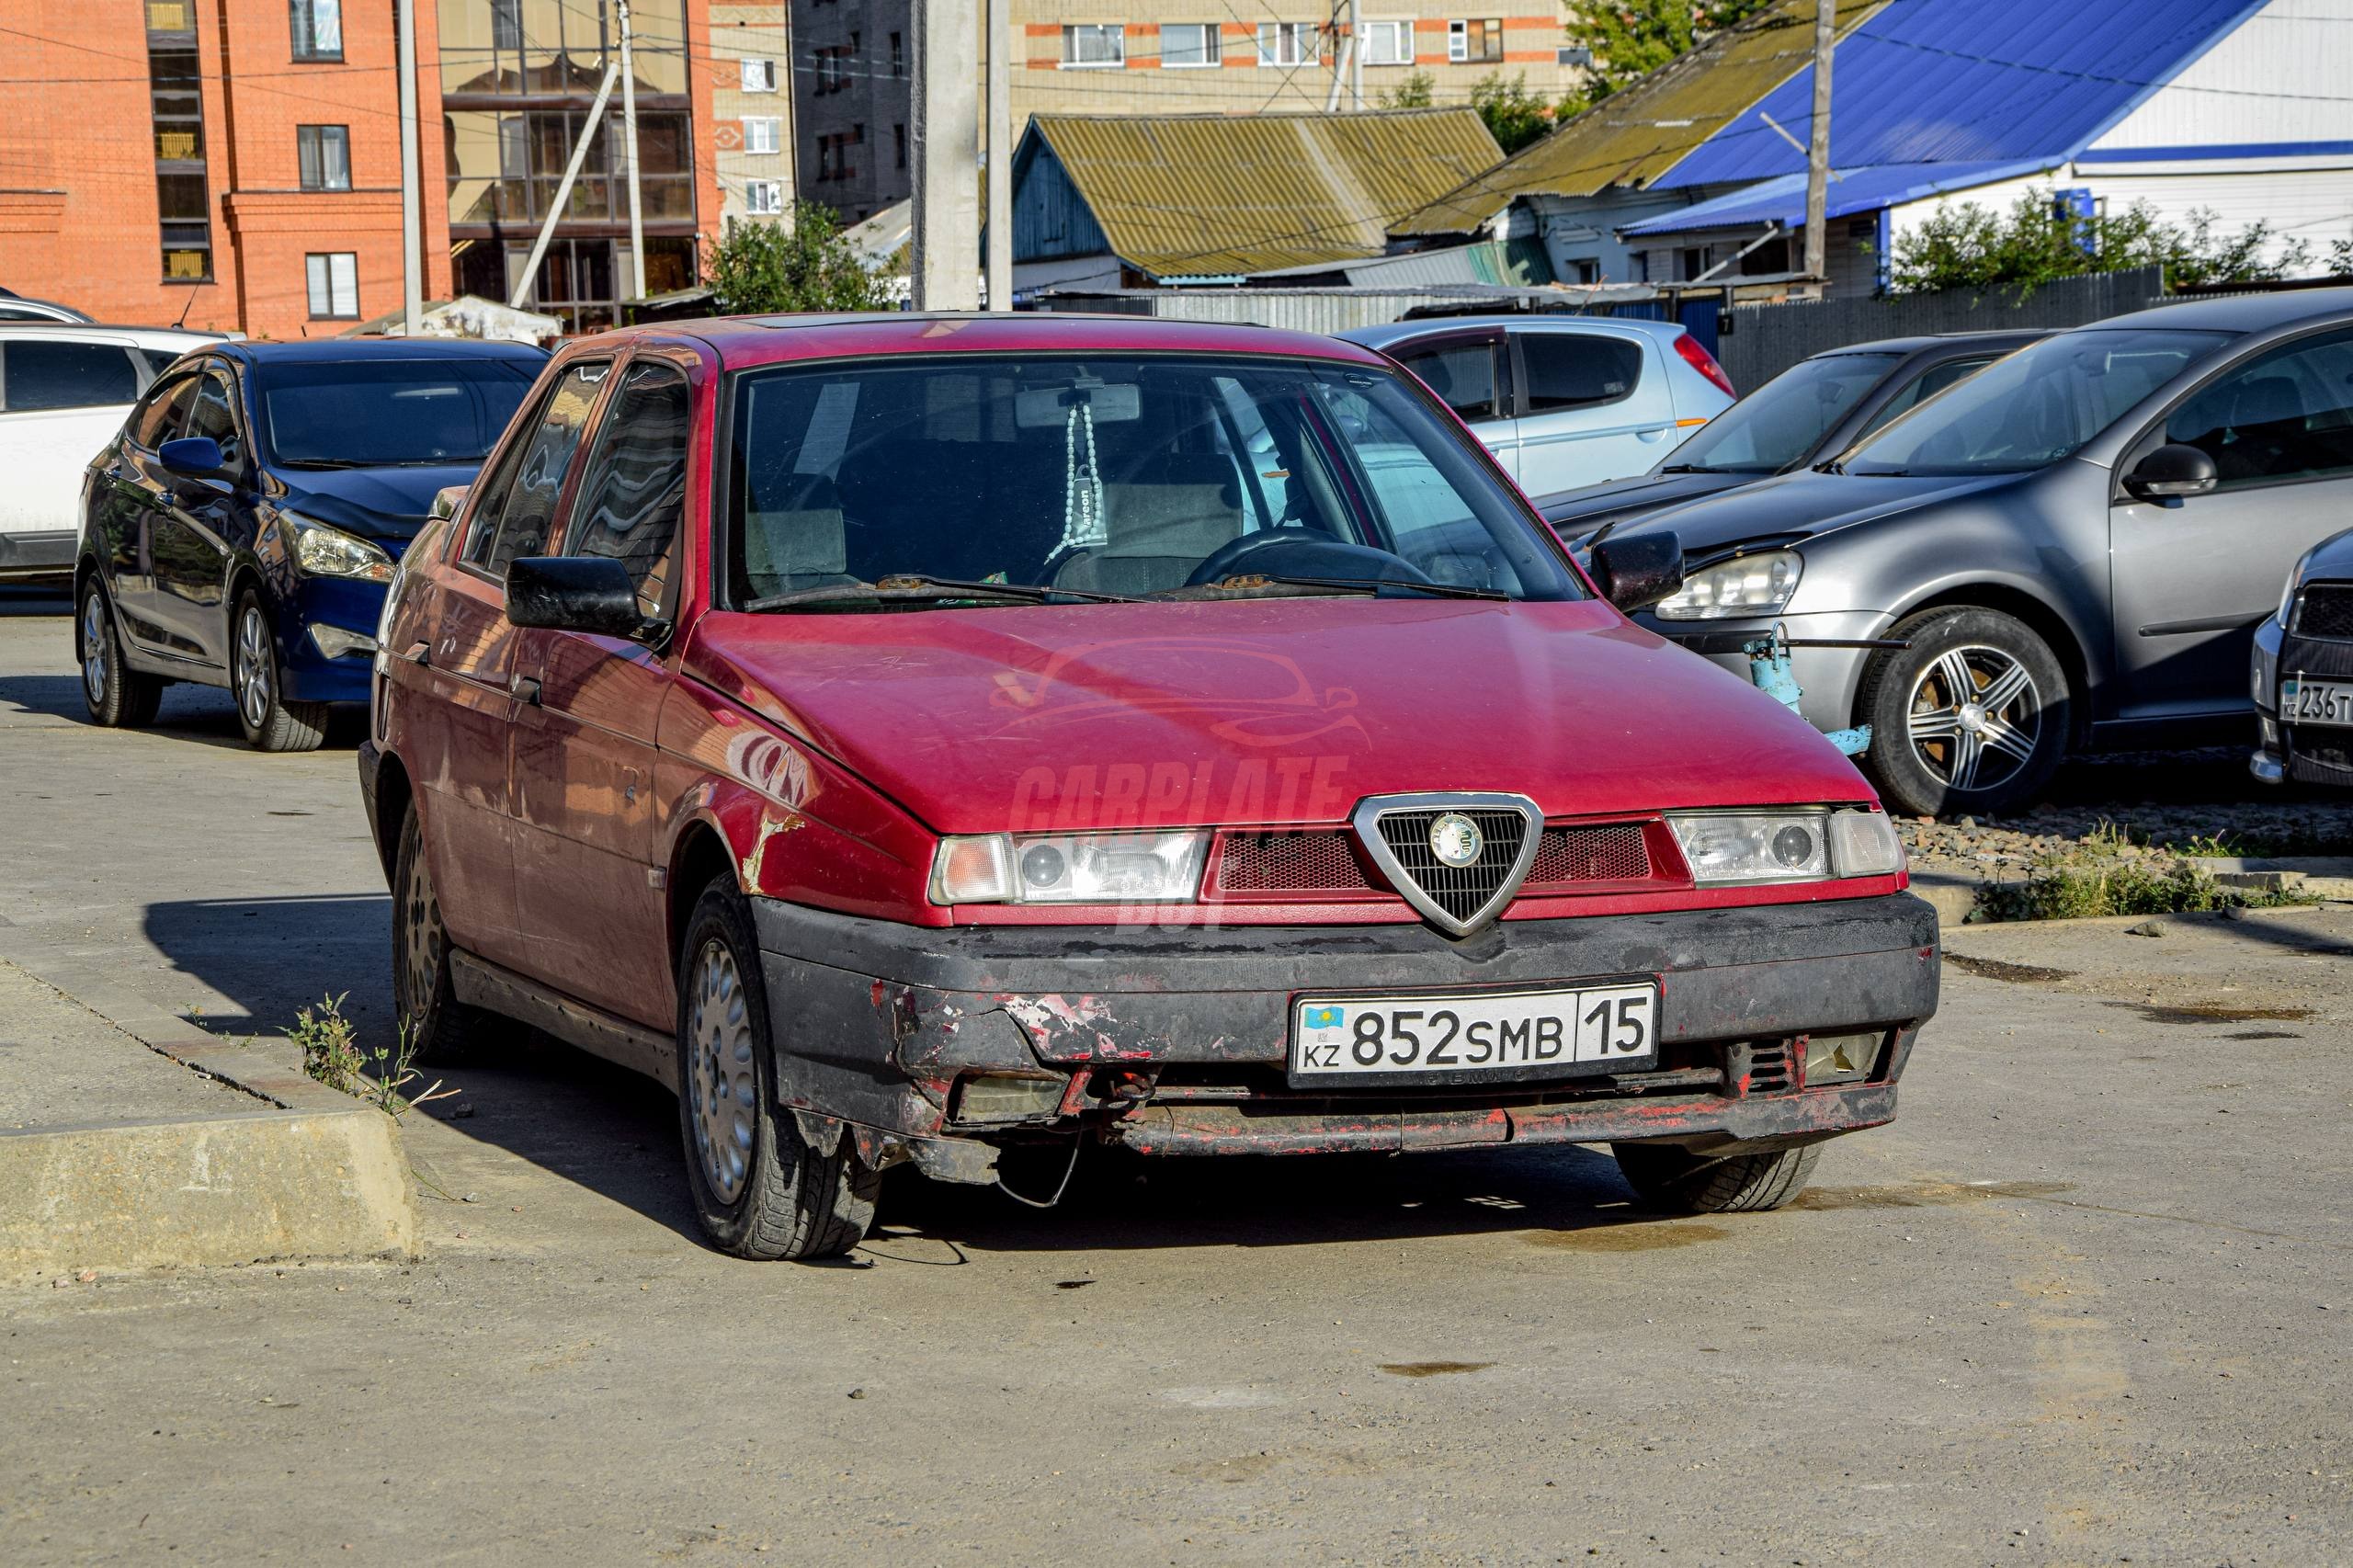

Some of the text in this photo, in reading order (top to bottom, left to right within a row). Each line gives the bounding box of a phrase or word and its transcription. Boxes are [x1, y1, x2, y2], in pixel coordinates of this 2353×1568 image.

[1081, 490, 1091, 526] areon
[2300, 686, 2353, 722] 236T
[1303, 996, 1647, 1067] KZ 852SMB 15
